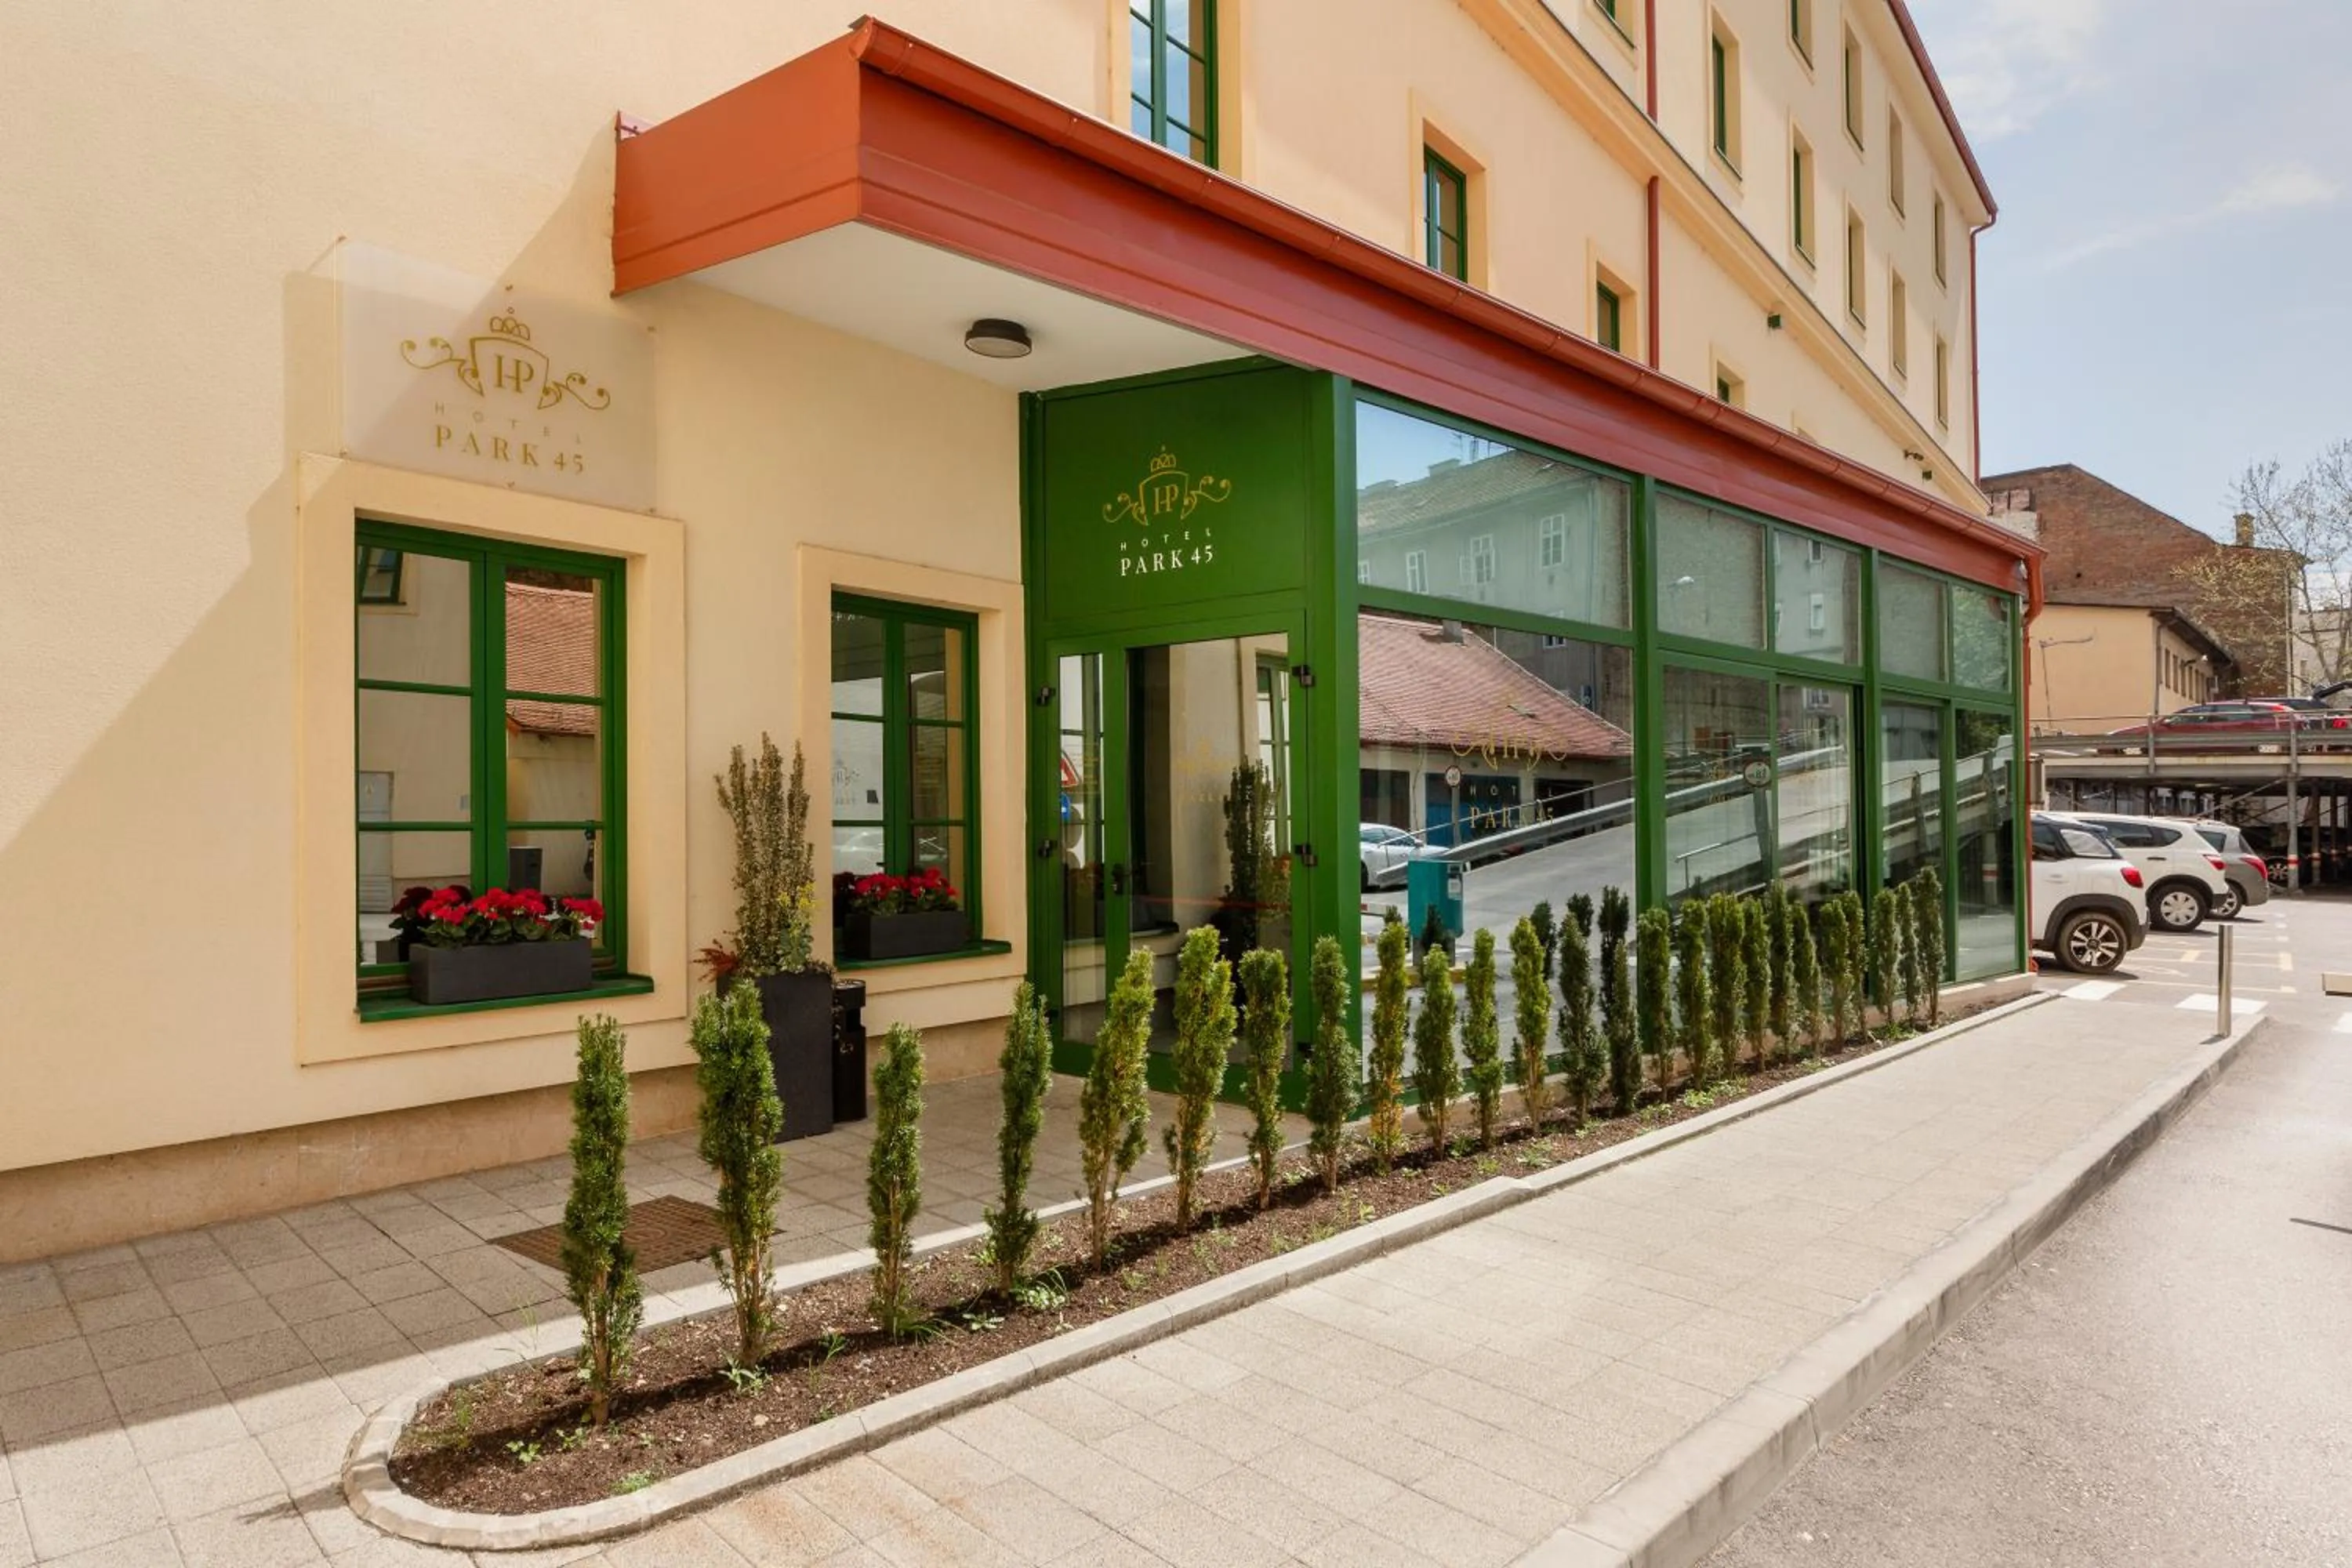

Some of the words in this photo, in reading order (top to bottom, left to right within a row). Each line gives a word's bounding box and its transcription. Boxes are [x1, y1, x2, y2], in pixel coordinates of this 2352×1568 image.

[435, 425, 539, 467] PARK
[554, 452, 583, 475] 45
[1120, 527, 1212, 551] HOTEL
[1120, 549, 1184, 576] PARK
[1191, 544, 1214, 564] 45
[1469, 785, 1552, 798] HOTL
